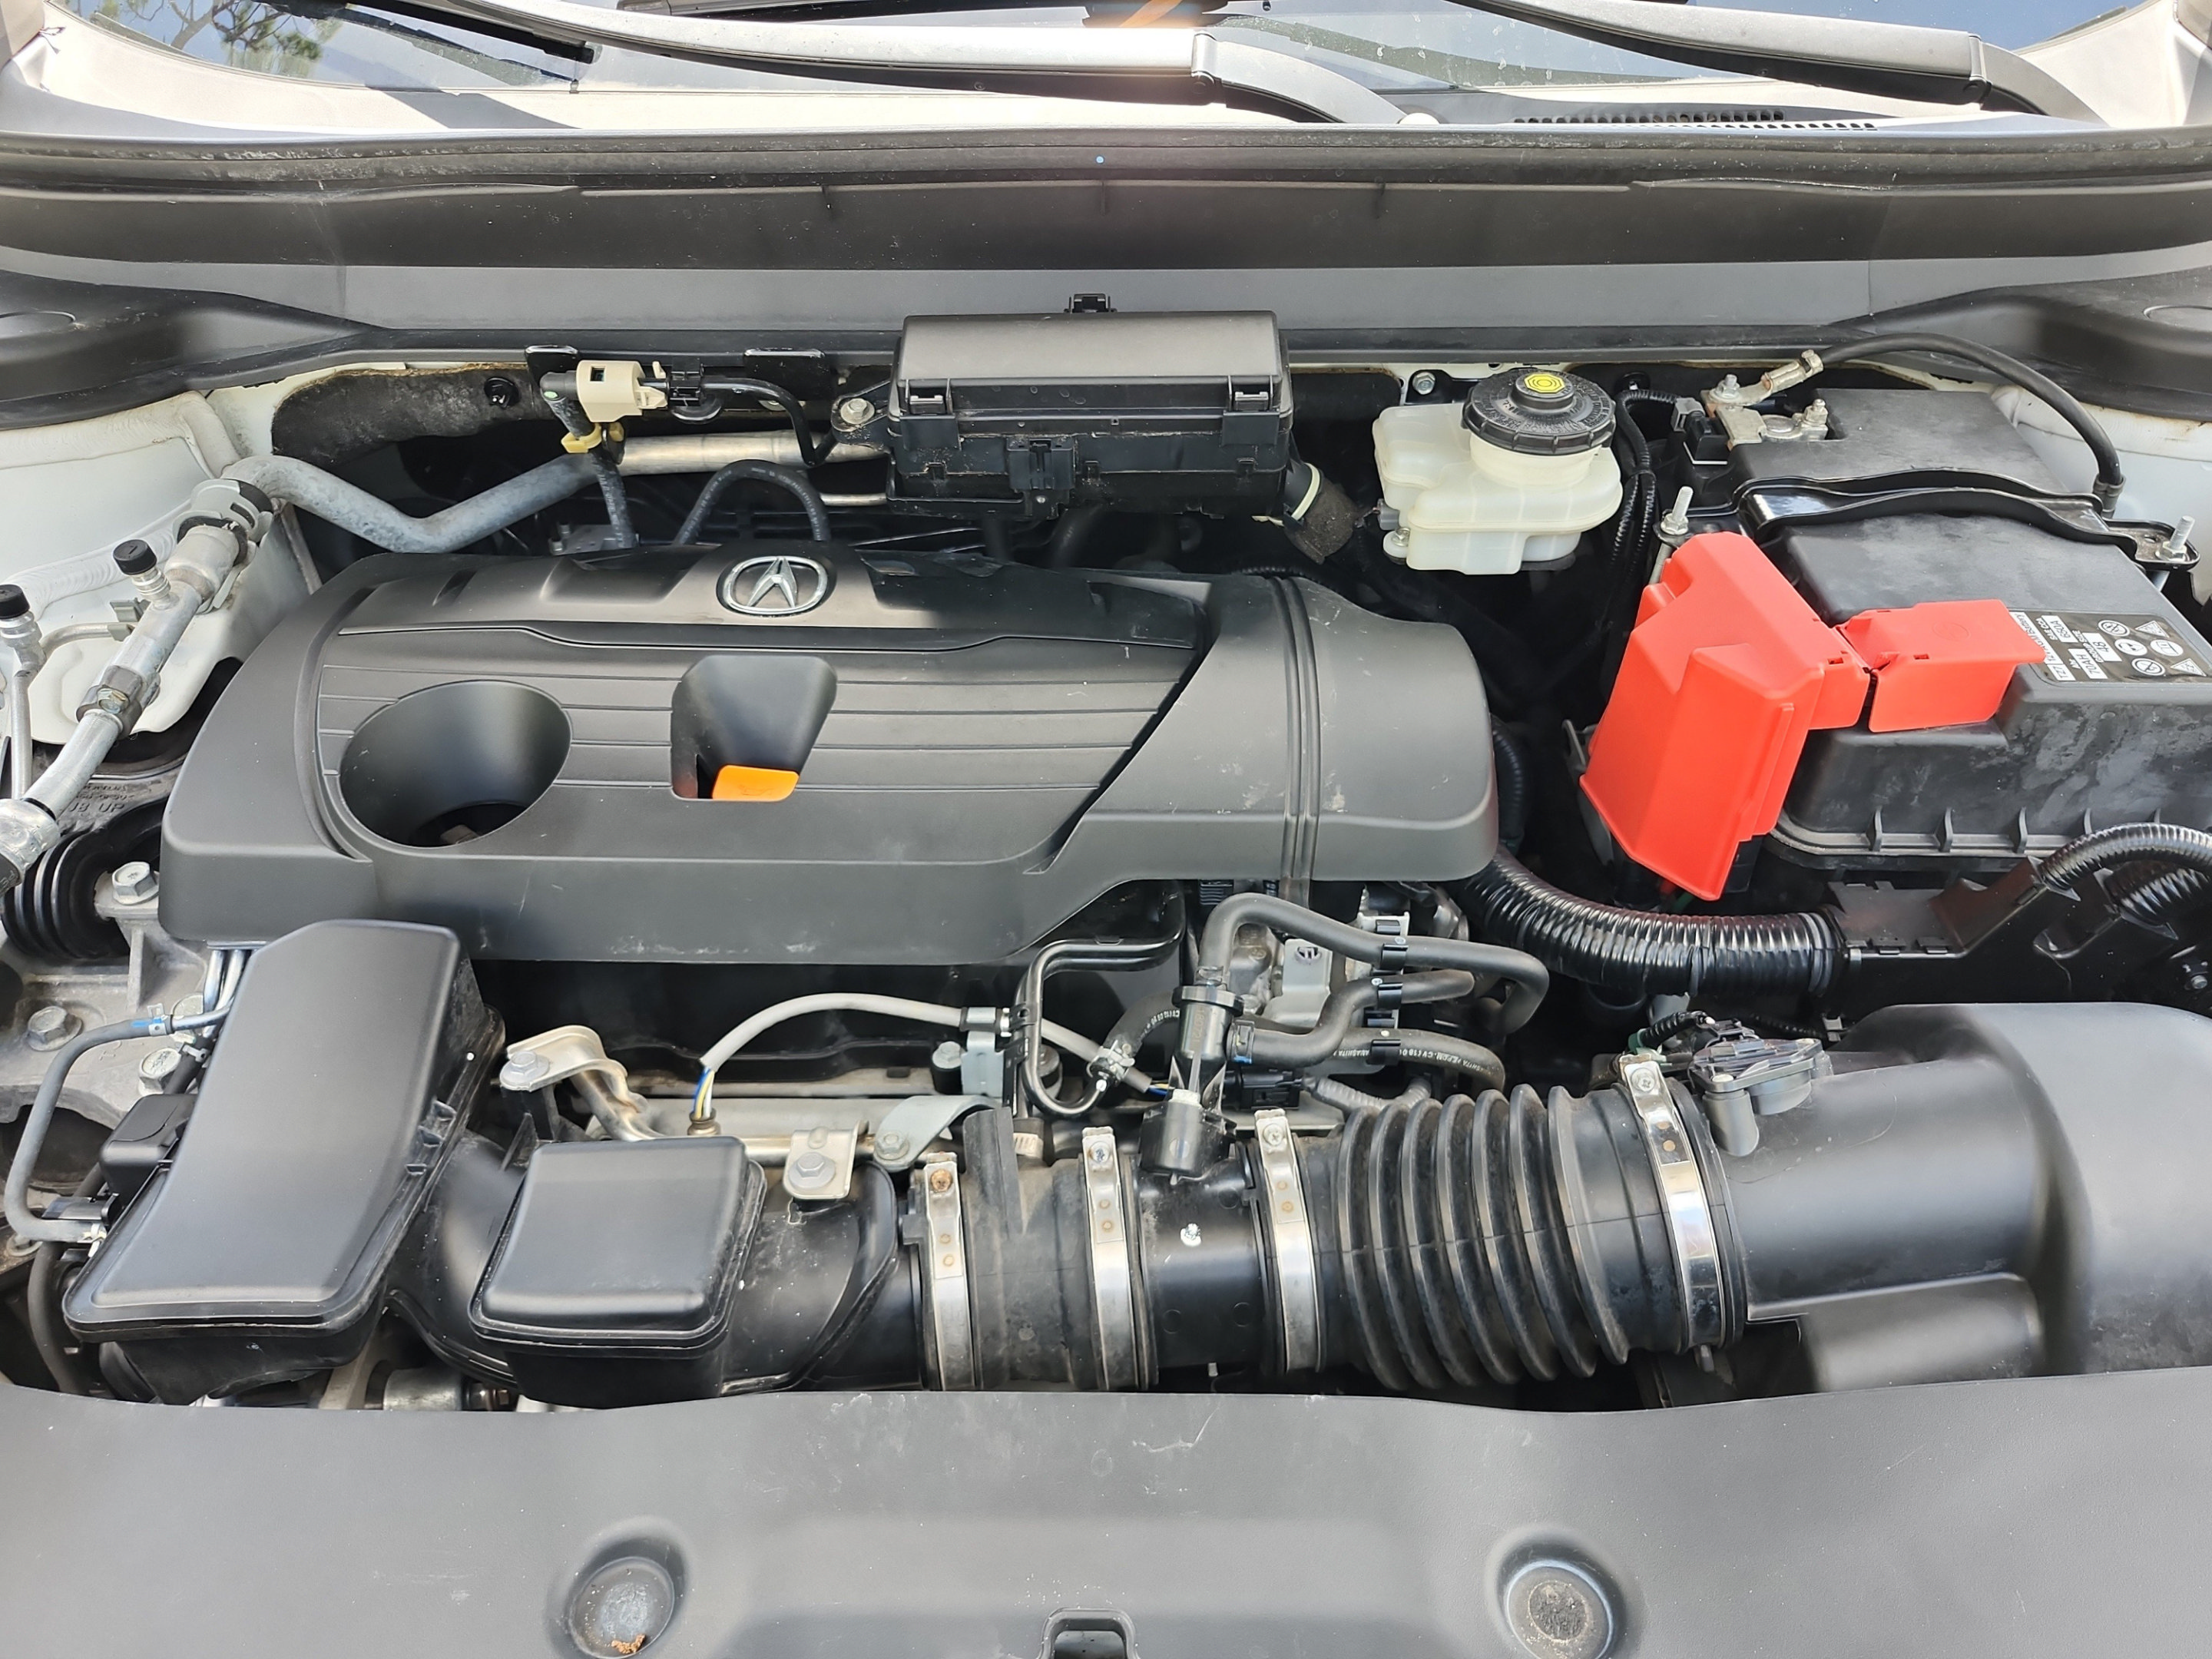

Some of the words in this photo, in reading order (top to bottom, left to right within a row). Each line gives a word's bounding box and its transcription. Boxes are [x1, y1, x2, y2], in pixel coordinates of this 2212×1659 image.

[2083, 643, 2104, 663] GROUP
[2093, 641, 2110, 653] 48
[2077, 654, 2101, 674] 70AH
[99, 803, 125, 813] UP
